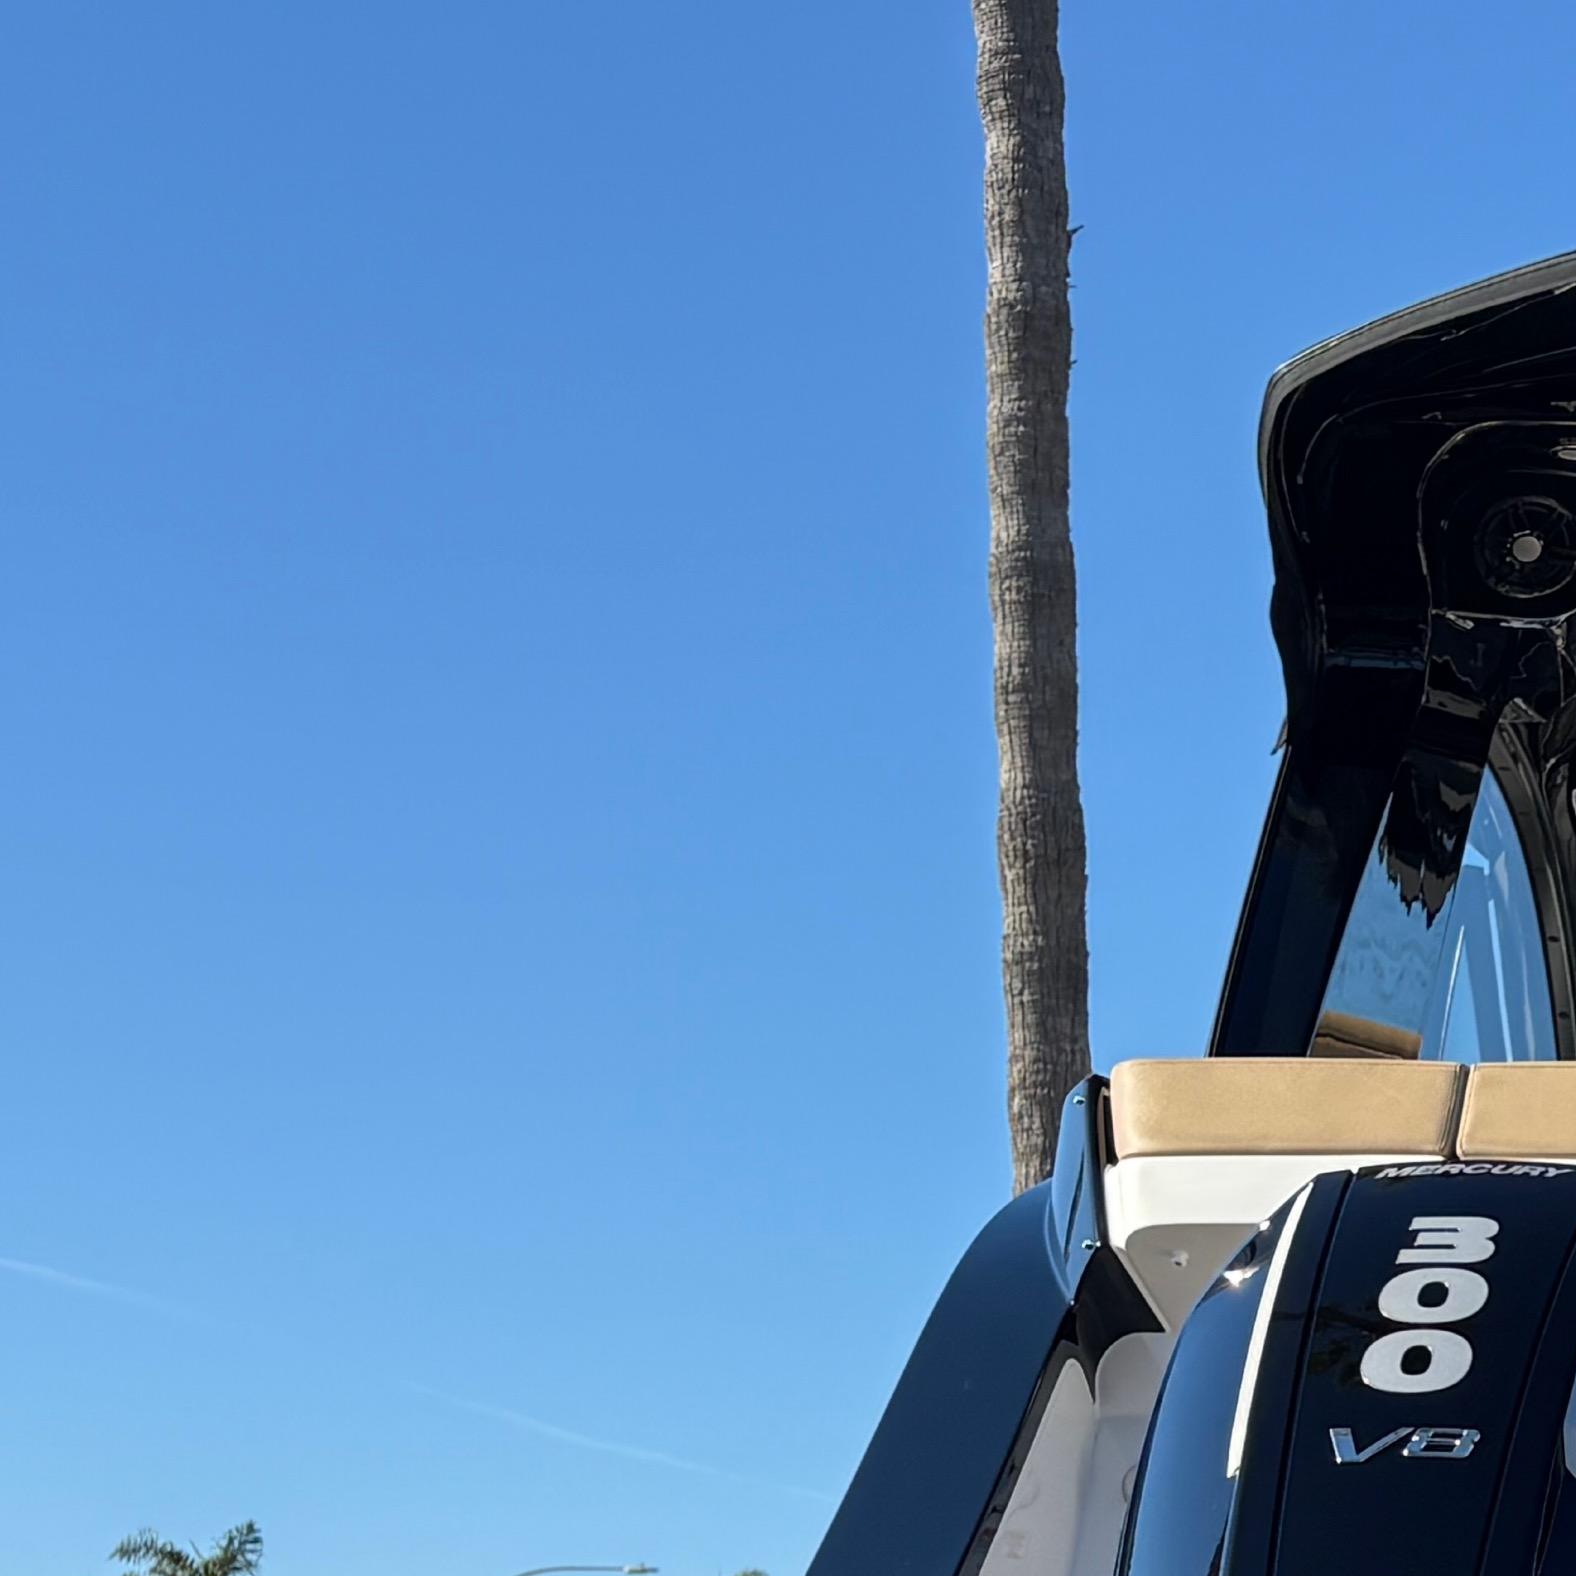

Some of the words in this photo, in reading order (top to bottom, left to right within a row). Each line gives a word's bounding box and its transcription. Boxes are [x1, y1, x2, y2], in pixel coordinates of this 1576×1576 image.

[1373, 1162, 1576, 1180] MERCURY
[1359, 1215, 1500, 1393] 300
[1329, 1426, 1482, 1464] V8
